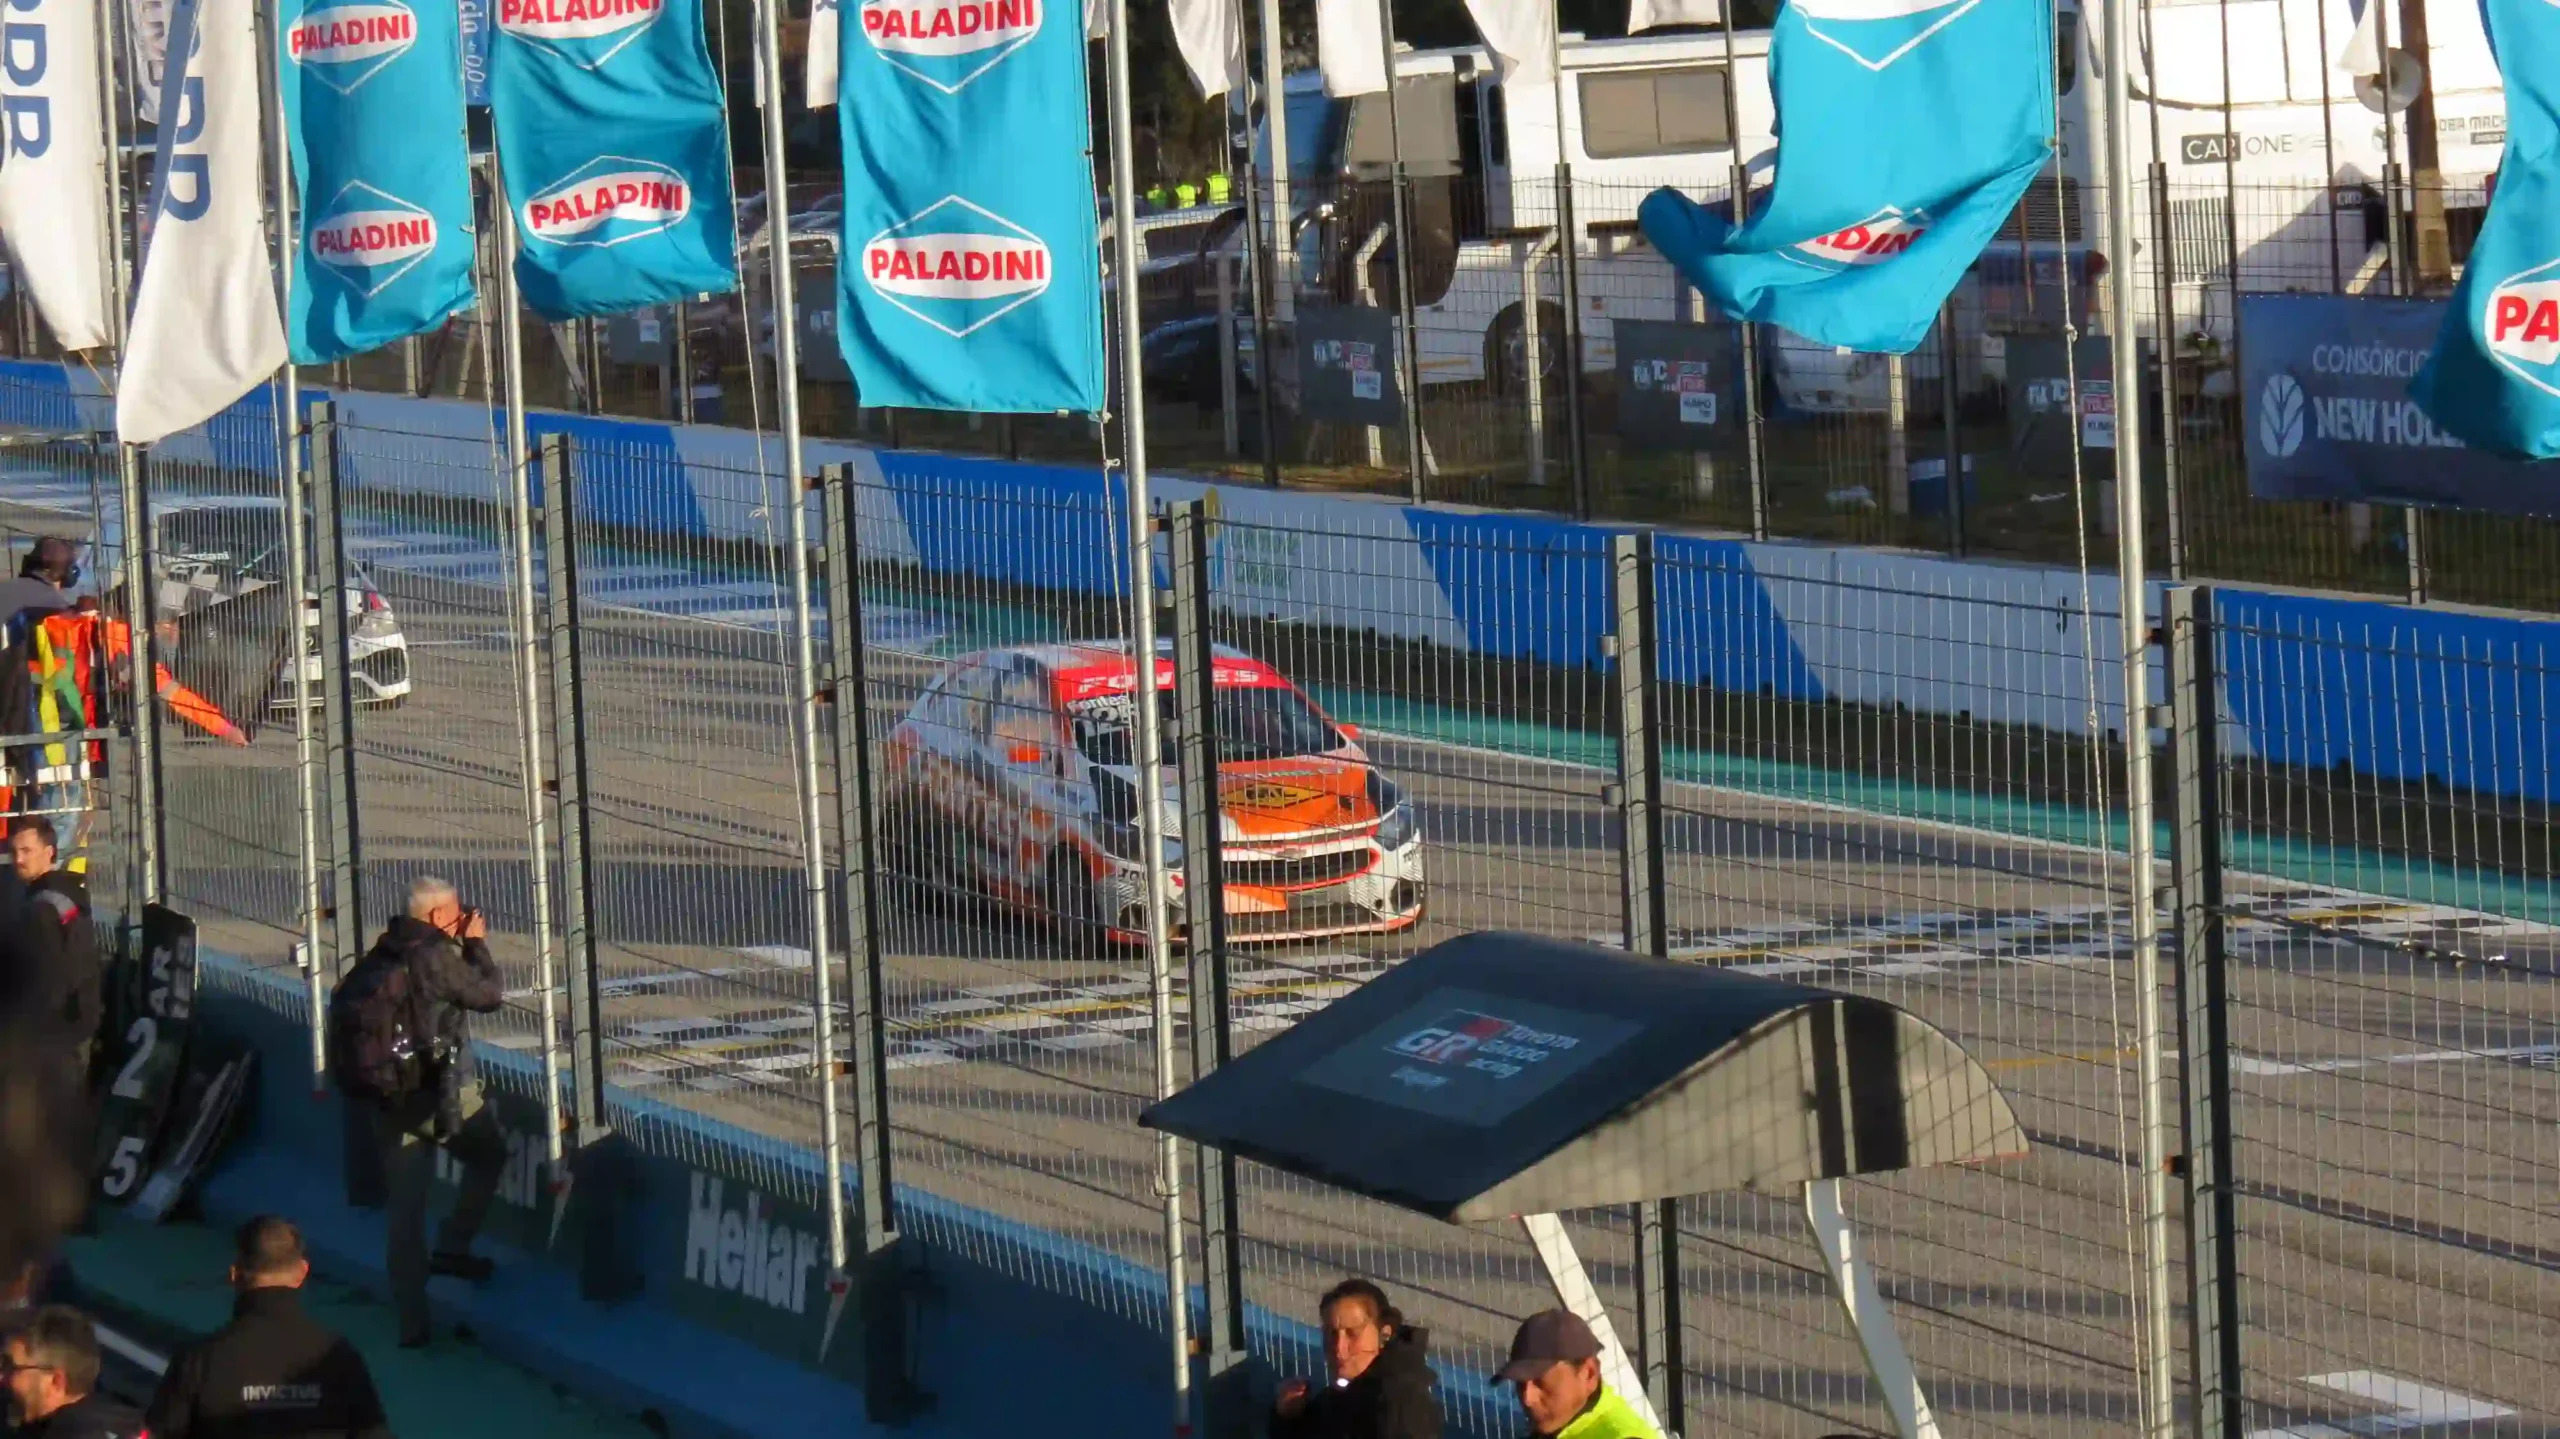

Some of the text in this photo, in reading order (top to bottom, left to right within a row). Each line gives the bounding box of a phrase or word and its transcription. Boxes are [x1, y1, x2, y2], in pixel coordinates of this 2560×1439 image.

[501, 0, 660, 24] PALADINI
[865, 0, 1034, 39] PALADINI
[292, 15, 410, 53] PALADINI
[2186, 134, 2292, 160] CAR ONE
[530, 181, 684, 230] PALADINI
[316, 219, 430, 256] PALADINI
[871, 249, 1044, 281] PALADINI
[2313, 396, 2377, 442] NEW
[112, 1018, 157, 1099] 2
[103, 1136, 145, 1196] 5
[685, 1170, 818, 1314] Heliar
